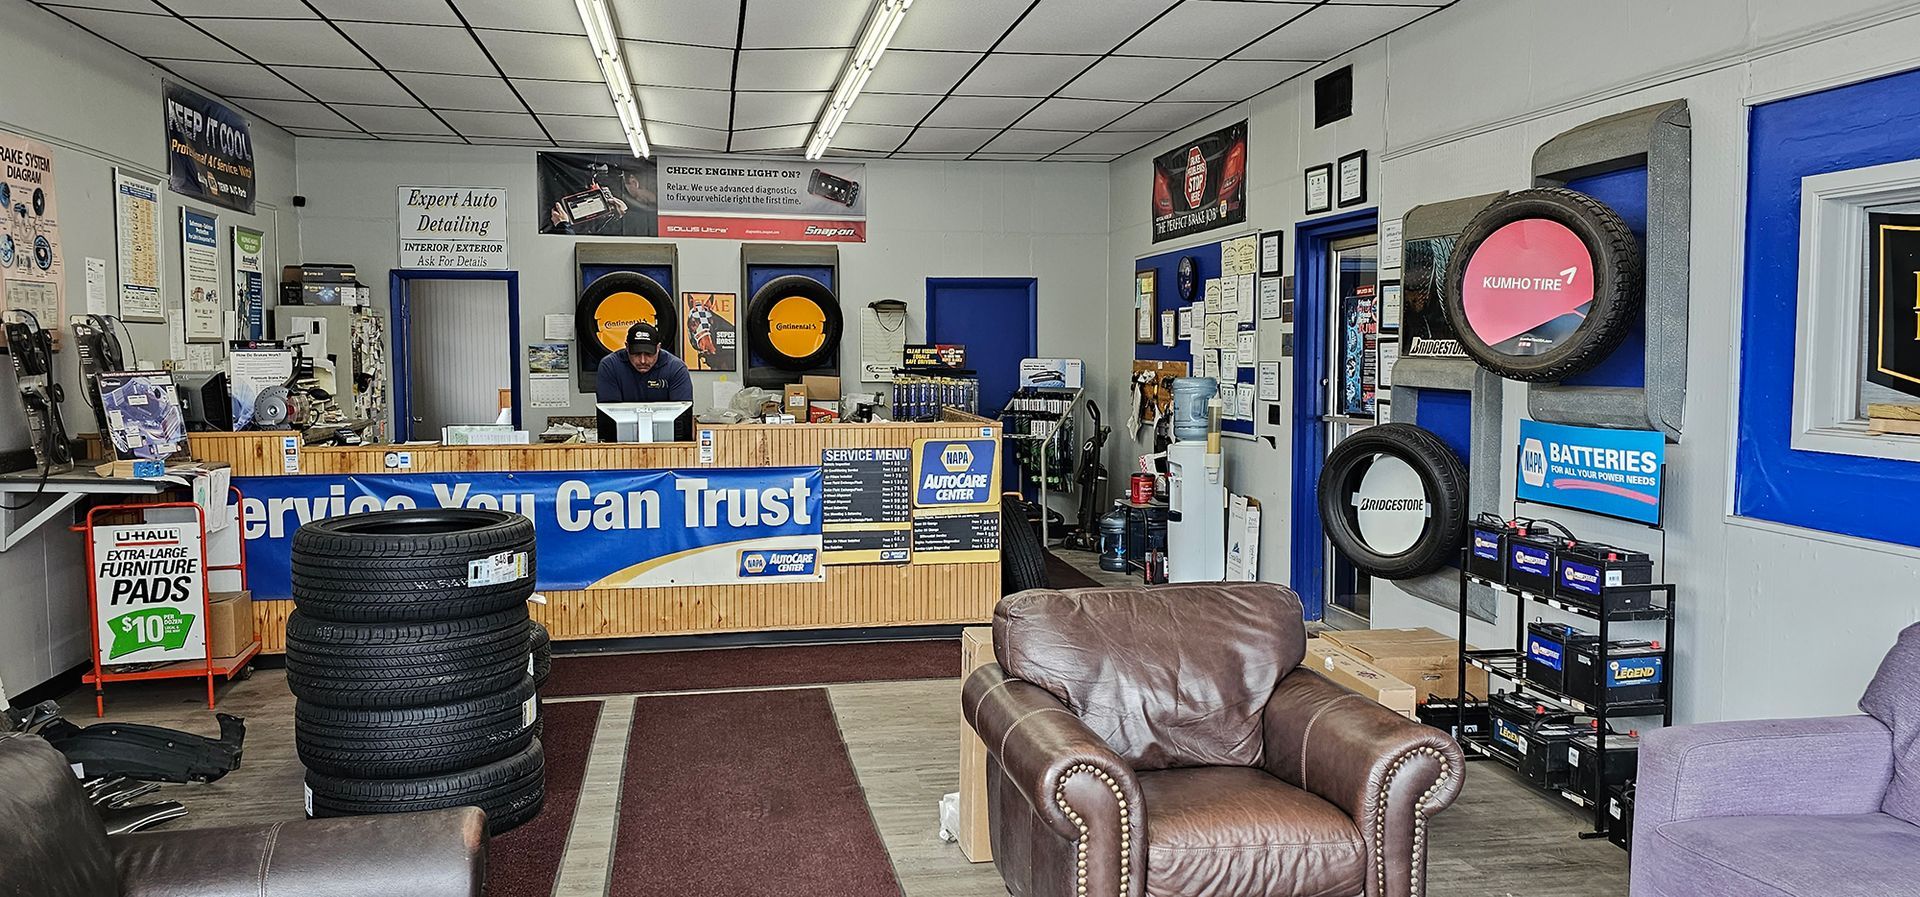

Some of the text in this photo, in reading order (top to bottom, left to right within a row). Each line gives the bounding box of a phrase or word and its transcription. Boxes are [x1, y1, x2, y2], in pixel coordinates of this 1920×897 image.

[168, 98, 251, 160] KEEP IT COOL
[25, 152, 50, 173] SYSTEM
[7, 165, 41, 184] DIAGRAM
[666, 167, 801, 179] CHECK ENGINE LIGHT ON?
[666, 182, 689, 191] Relax.
[690, 183, 703, 192] We
[719, 184, 754, 193] advanced
[755, 185, 797, 196] diagnostics
[1188, 174, 1203, 193] STOP
[407, 189, 498, 210] Expert Auto
[666, 193, 802, 205] to fix your vehicle right the first time.
[416, 214, 491, 236] Detailing
[1156, 222, 1166, 235] THE
[1166, 215, 1188, 232] PERFECT
[1188, 210, 1205, 227] BRAKE
[804, 225, 855, 237] Snap-on
[404, 243, 449, 252] INTERIOR
[455, 244, 503, 253] EXTERIOR
[417, 255, 488, 267] Ask For Details
[1483, 277, 1562, 291] KUMHO TIRE
[776, 322, 811, 331] Continental
[825, 449, 907, 461] SERVICE MENU
[946, 451, 969, 465] NAPA
[1550, 442, 1657, 474] BATTERIES
[1524, 450, 1544, 475] NAPA
[923, 473, 988, 490] AUTOCARE
[1551, 464, 1656, 486] FOR ALL YOUR POWER NEEDS
[936, 489, 974, 501] CENTER
[555, 480, 661, 532] Can
[675, 477, 811, 528] Trust
[1360, 498, 1423, 511] BRIDGESTONE
[107, 547, 188, 561] EXTRA-LARGE
[99, 559, 198, 578] FURNITURE
[748, 559, 763, 568] NAPA
[777, 564, 805, 572] CENTER
[111, 576, 192, 606] PADS
[122, 615, 164, 643] $10
[1615, 667, 1655, 680] LEGEND
